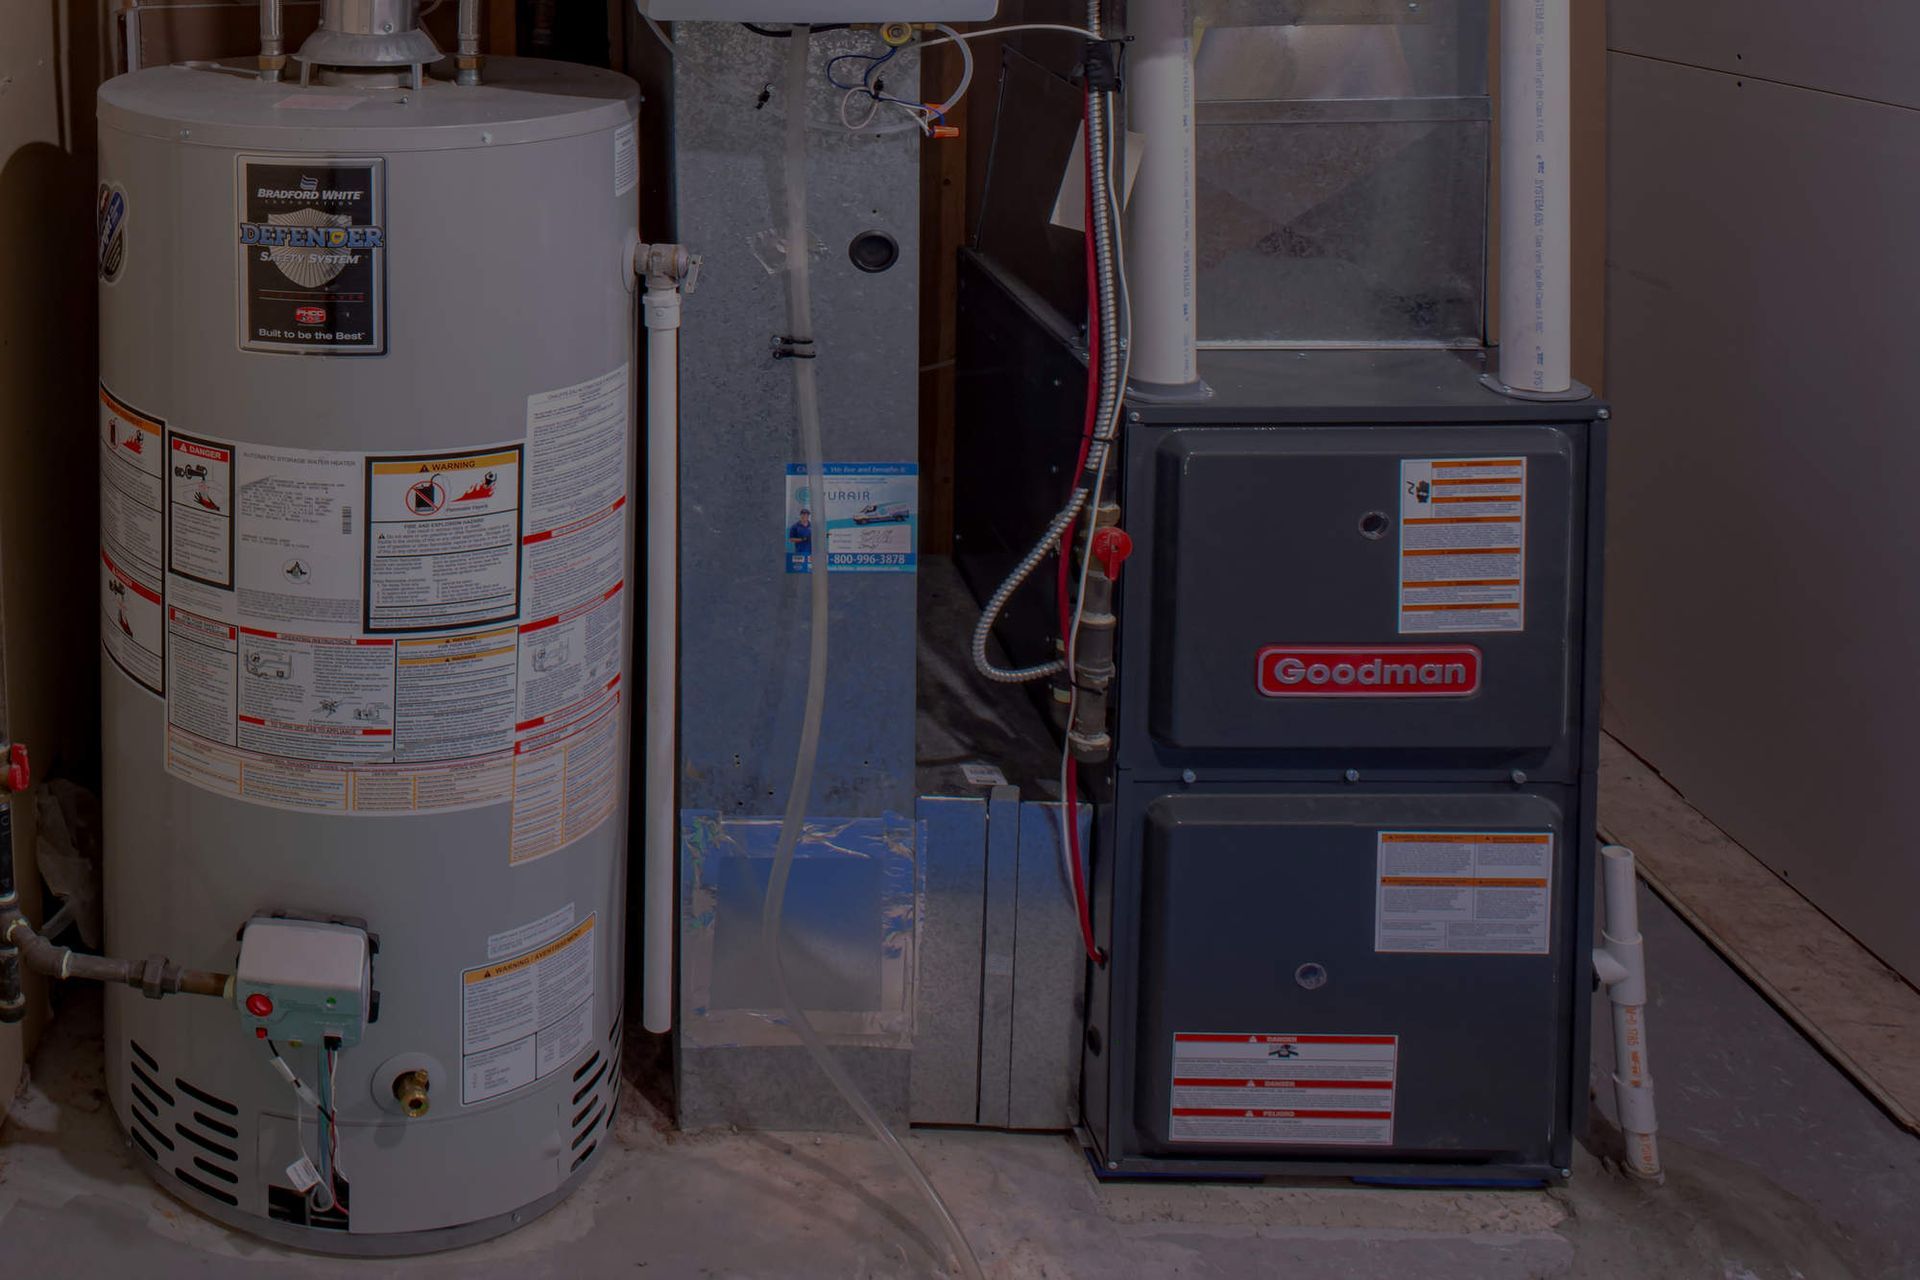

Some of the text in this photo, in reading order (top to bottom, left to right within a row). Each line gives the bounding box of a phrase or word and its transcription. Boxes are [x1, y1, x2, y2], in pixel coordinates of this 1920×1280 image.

[257, 188, 361, 200] BRADFORD WHITE
[1534, 179, 1544, 211] SYSTEM
[240, 223, 385, 249] DEFENDER
[260, 251, 361, 264] SAFETY SYSTEM
[259, 328, 361, 340] Built to be the Best
[189, 446, 222, 460] DANGER
[432, 460, 475, 471] WARNING
[825, 491, 871, 501] URAIR
[1274, 657, 1466, 685] Goodman
[495, 957, 530, 974] WARNING
